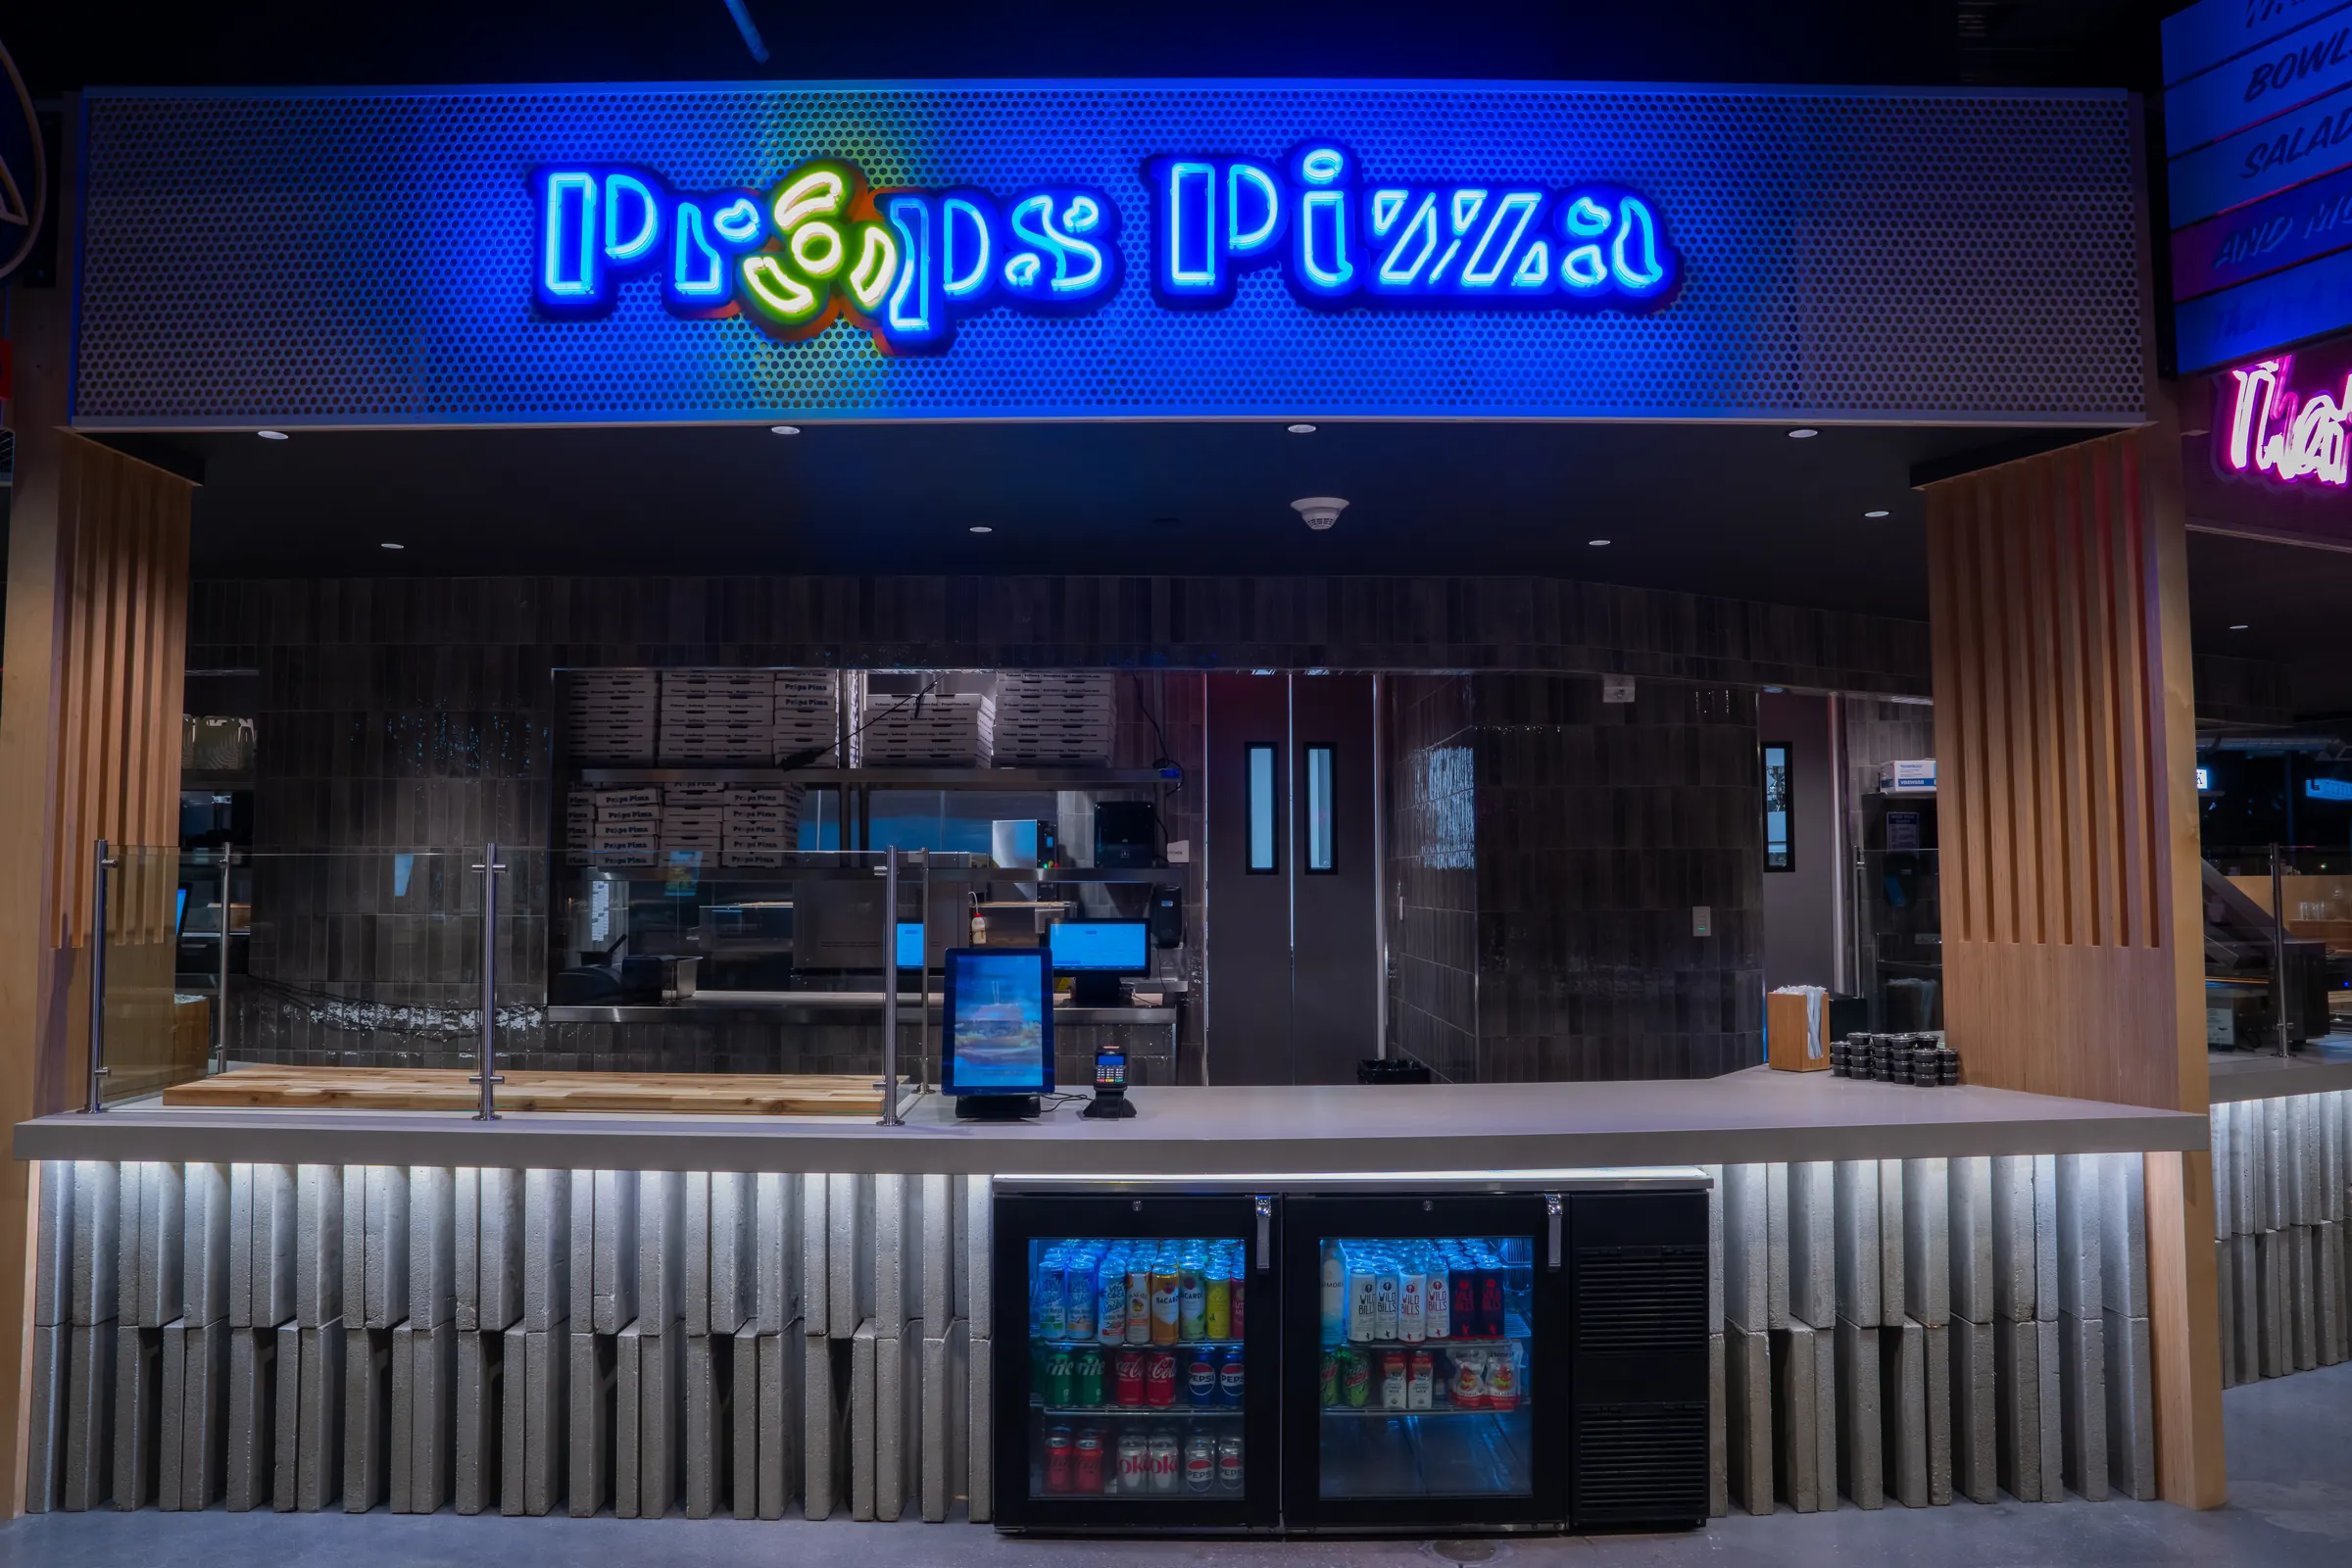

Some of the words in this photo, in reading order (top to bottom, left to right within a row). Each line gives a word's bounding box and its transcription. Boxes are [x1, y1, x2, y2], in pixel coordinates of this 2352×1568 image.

[2244, 26, 2352, 103] BOWL
[545, 169, 1102, 332] Props
[1171, 147, 1663, 287] Pizza
[2212, 215, 2293, 270] AND
[1076, 1358, 1105, 1376] rite
[1221, 1374, 1245, 1383] PEPS
